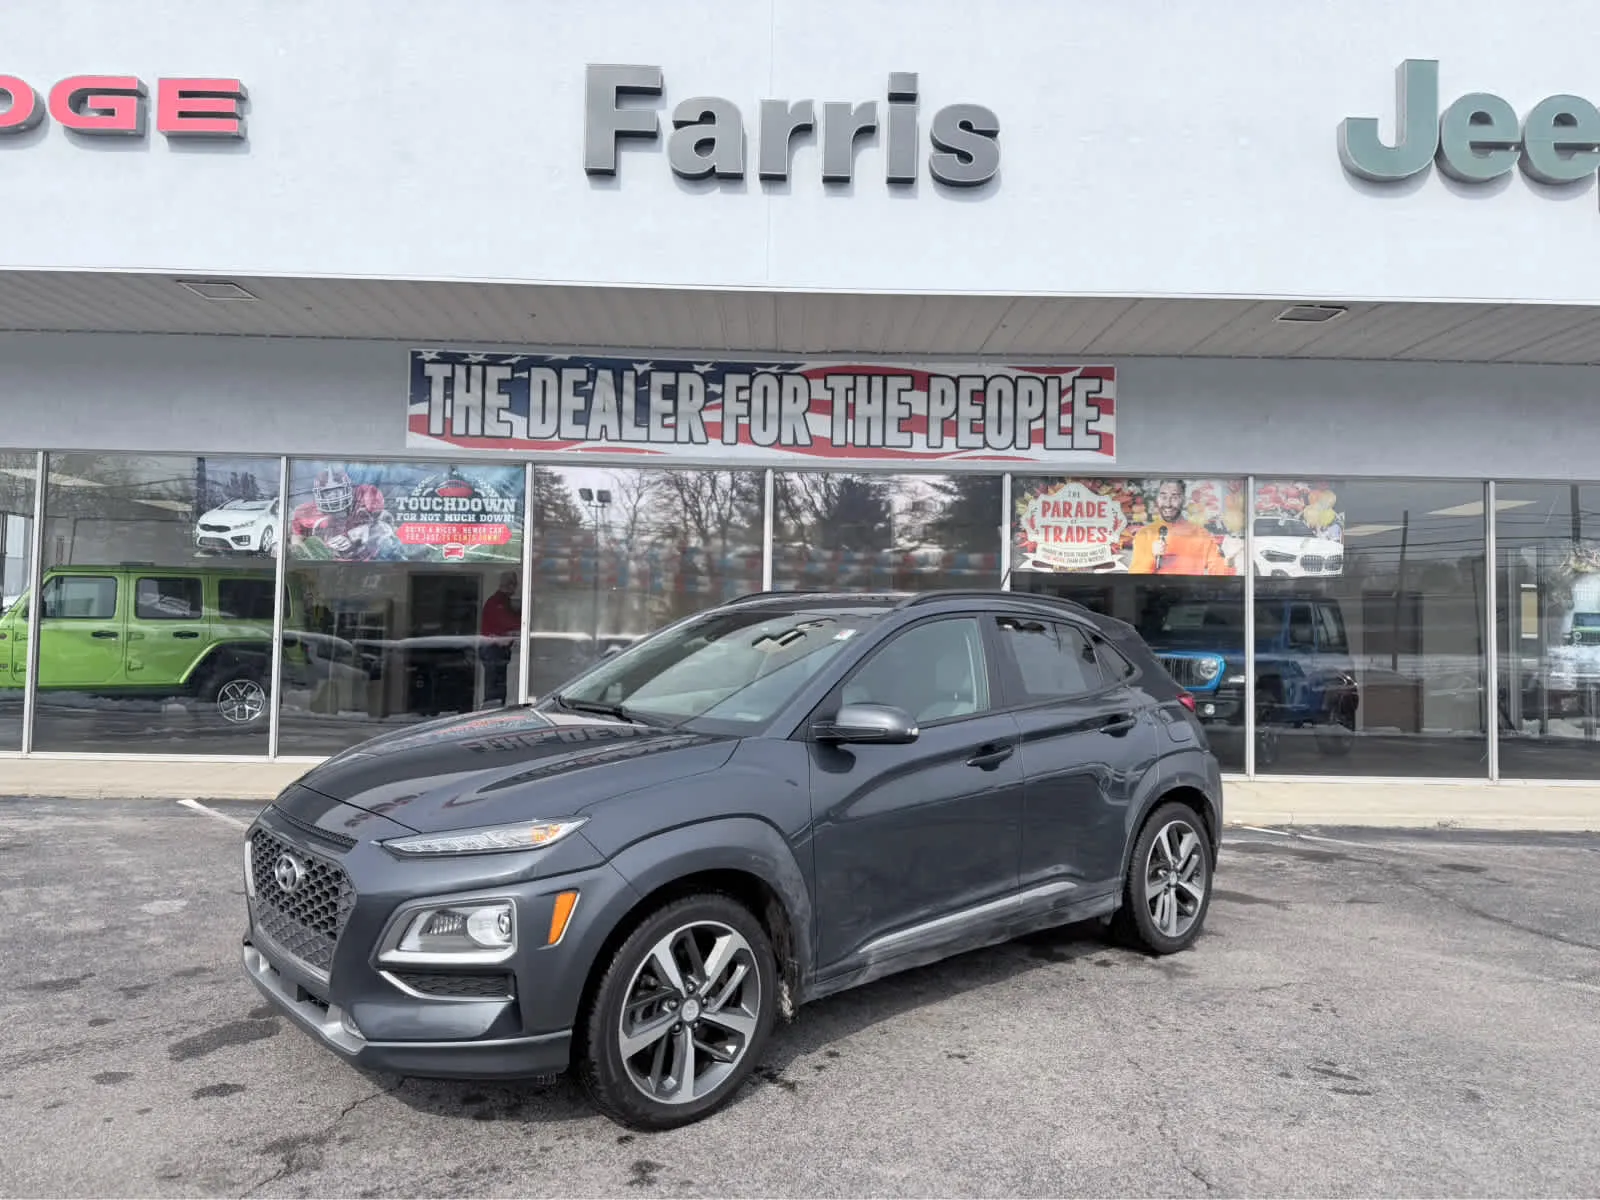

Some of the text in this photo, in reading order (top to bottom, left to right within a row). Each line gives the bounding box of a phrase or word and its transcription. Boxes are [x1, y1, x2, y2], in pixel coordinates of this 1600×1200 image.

[584, 63, 1000, 187] Farris
[1338, 59, 1600, 186] Jee
[423, 362, 1102, 450] THE DEALER FOR THE PEOPLE
[396, 496, 516, 512] TOUCHDOWN
[1041, 500, 1108, 518] PARADE
[396, 513, 515, 522] FOR NOT MUCH DOWN!
[1040, 525, 1108, 543] TRADES
